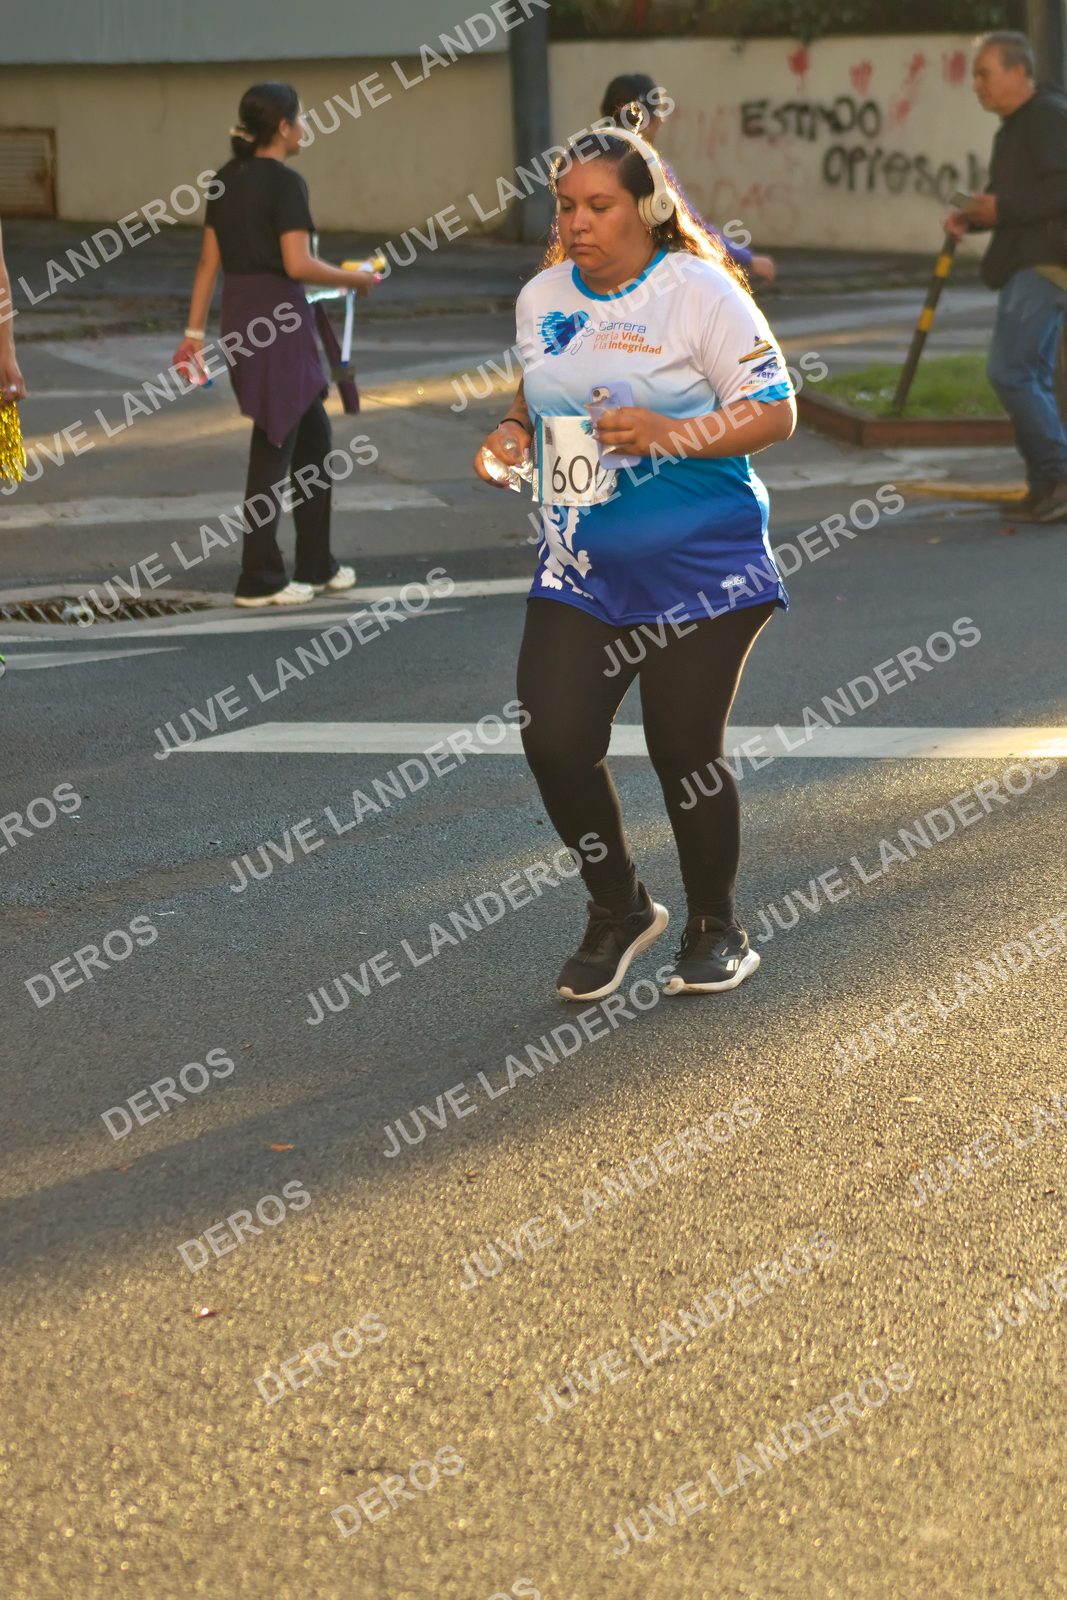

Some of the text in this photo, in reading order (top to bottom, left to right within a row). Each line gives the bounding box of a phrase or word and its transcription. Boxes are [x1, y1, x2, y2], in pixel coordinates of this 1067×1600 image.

[599, 321, 647, 334] Carrera
[622, 332, 645, 343] Vida
[608, 341, 662, 355] Integridad
